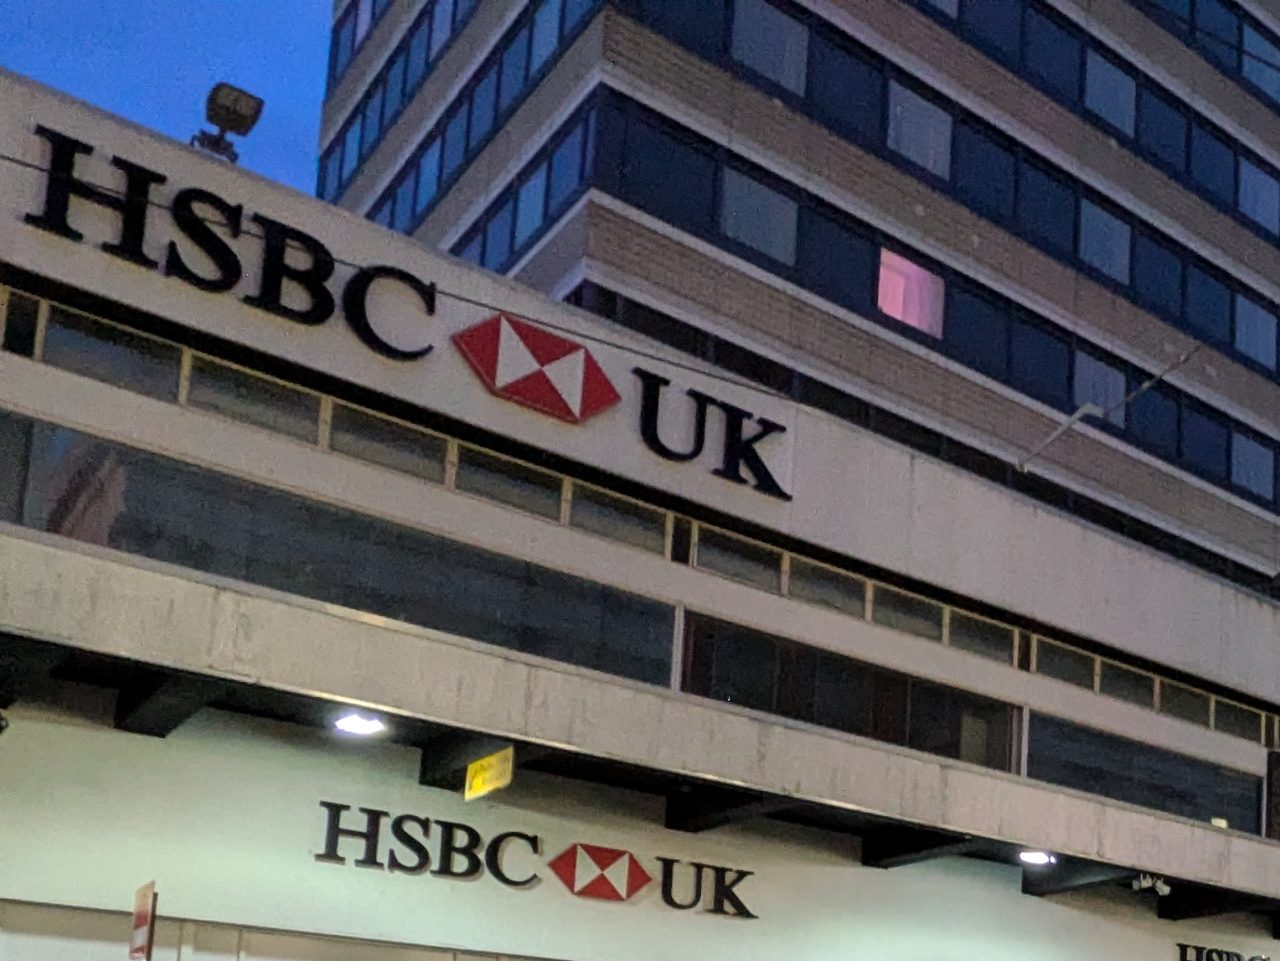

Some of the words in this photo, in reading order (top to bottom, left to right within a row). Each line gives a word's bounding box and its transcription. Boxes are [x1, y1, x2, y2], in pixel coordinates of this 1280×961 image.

[24, 124, 436, 360] HSBC
[632, 367, 793, 502] UK
[314, 800, 543, 888] HSBC
[656, 856, 758, 919] UK
